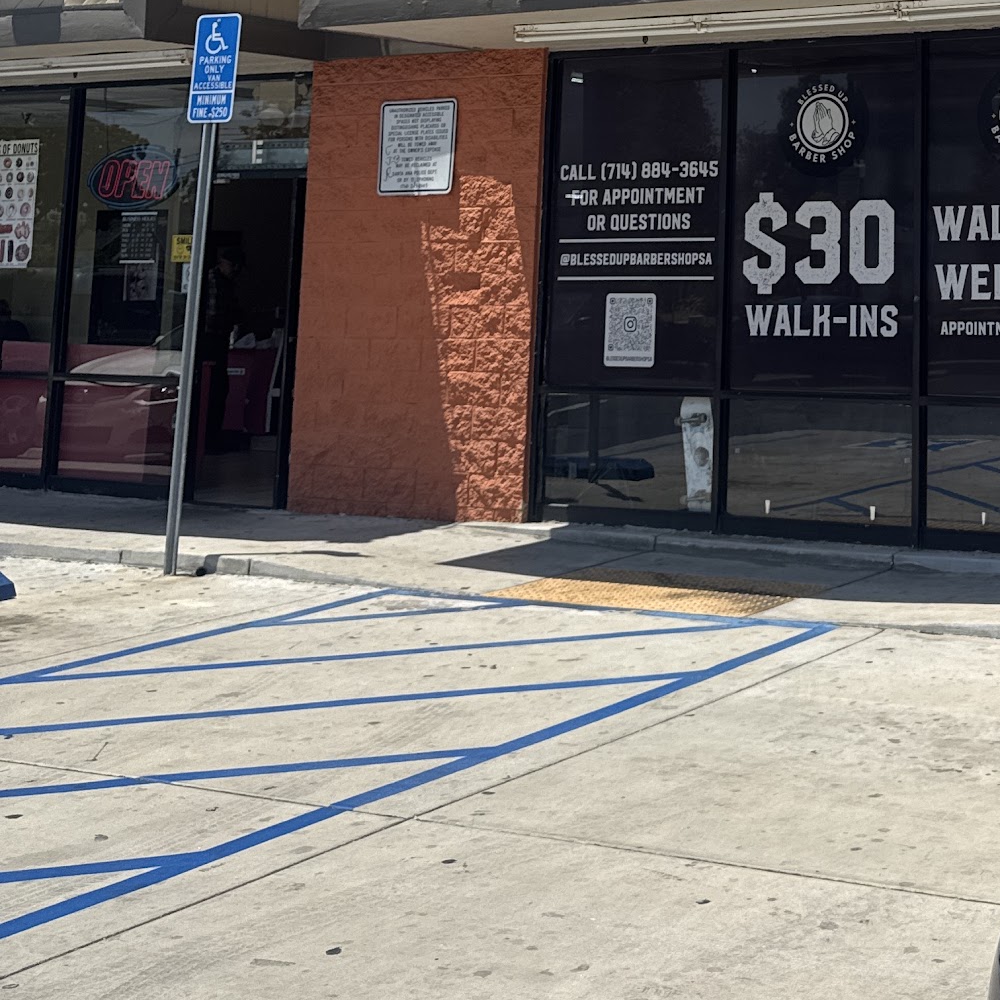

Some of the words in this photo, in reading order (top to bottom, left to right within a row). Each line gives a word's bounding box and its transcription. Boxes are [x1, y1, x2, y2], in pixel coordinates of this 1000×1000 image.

[199, 55, 232, 65] PARKING
[204, 65, 225, 74] ONLY
[193, 81, 232, 90] ACCESSIBLE
[797, 84, 836, 105] BLESSED
[837, 90, 849, 102] UP
[196, 94, 226, 106] MINIMUM
[192, 108, 209, 119] FINE
[13, 142, 38, 154] DONUTS
[251, 140, 263, 165] E
[789, 133, 826, 163] BARBER
[831, 131, 856, 160] SHOP
[98, 159, 171, 200] OPEN
[560, 164, 596, 181] CALL
[601, 161, 637, 181] (714)
[641, 160, 719, 178] 884-3645
[571, 189, 598, 206] FOR
[602, 187, 705, 205] APPOINTMENT
[587, 214, 606, 231] OR
[610, 213, 691, 231] QUESTIONS
[176, 236, 193, 245] SMIL
[742, 192, 895, 295] $30
[560, 253, 712, 266] @BLESSEDUPBARBERSHOPSA
[745, 304, 898, 337] WALK-INS
